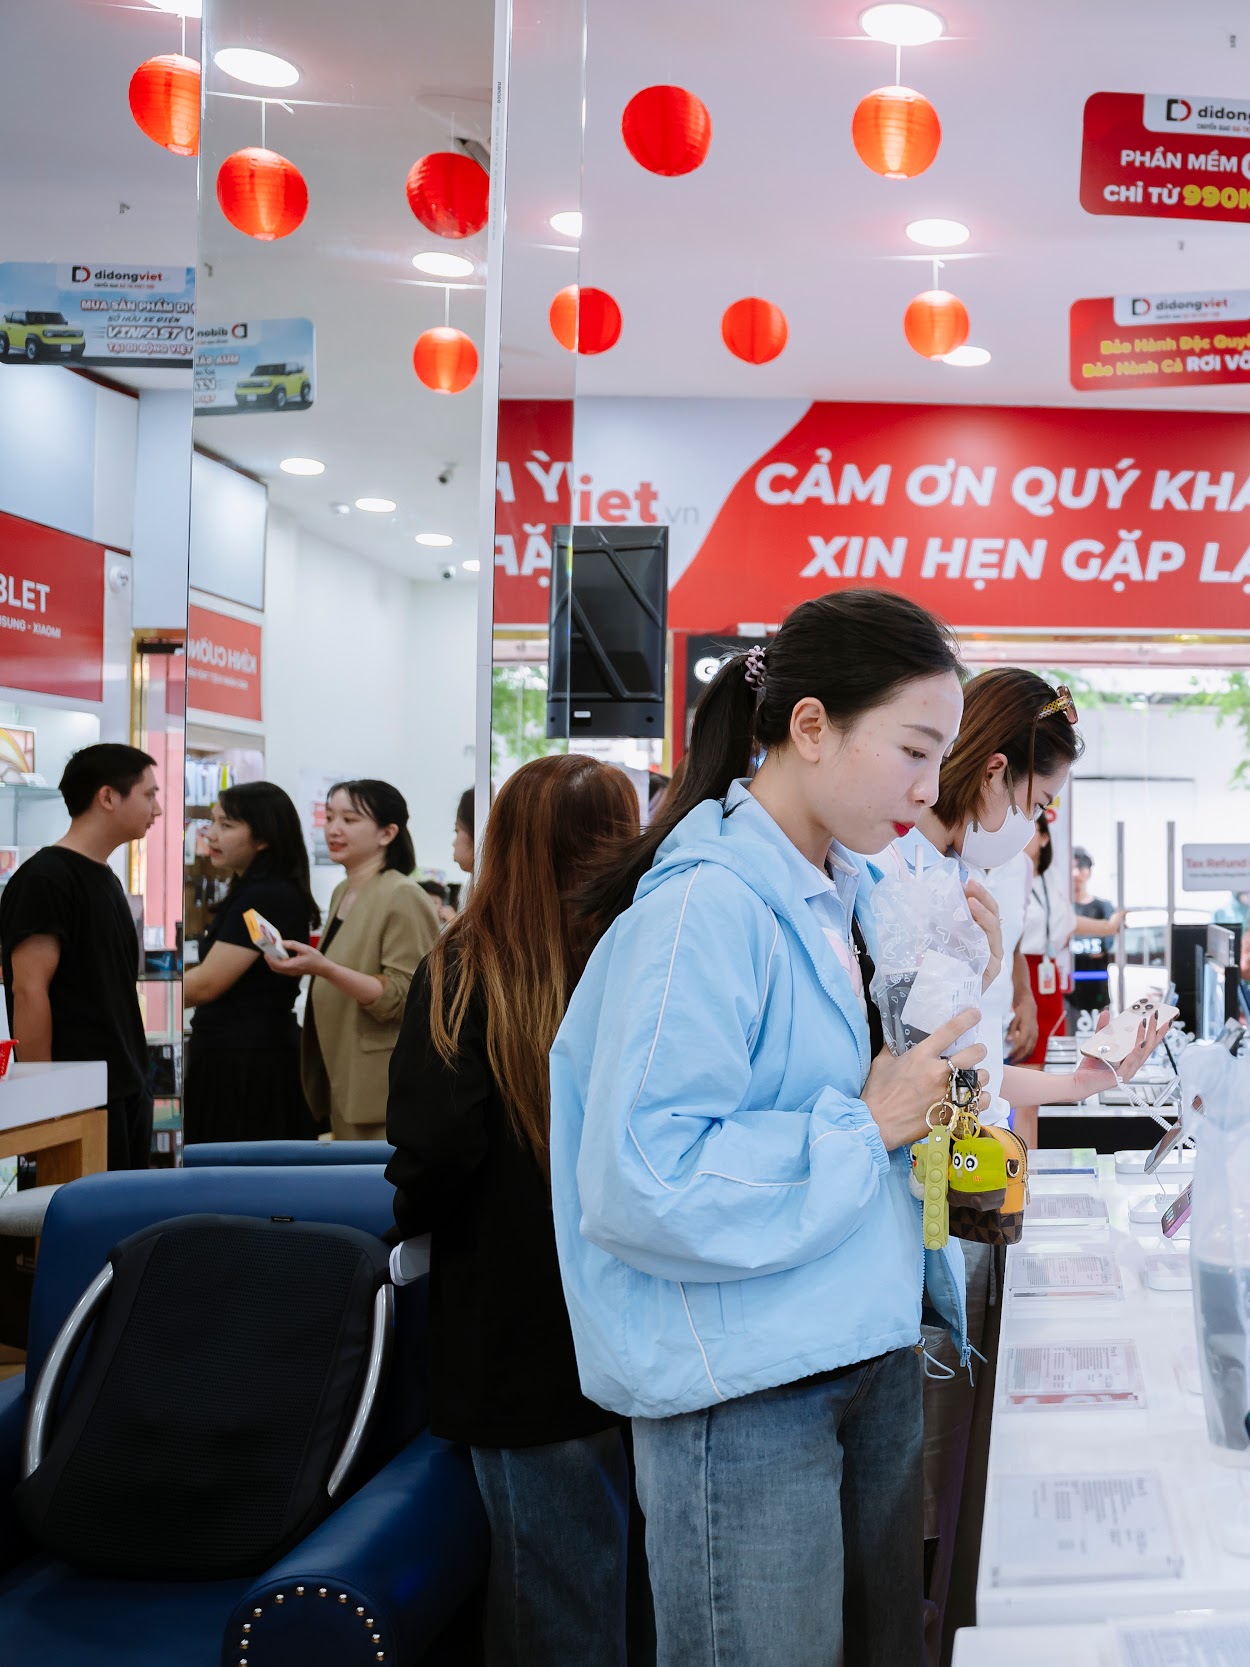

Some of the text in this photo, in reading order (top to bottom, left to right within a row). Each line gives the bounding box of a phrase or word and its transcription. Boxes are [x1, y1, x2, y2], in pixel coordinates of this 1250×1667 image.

[1187, 149, 1238, 173] MỀM
[1103, 181, 1143, 203] CHỈ
[1148, 183, 1181, 205] TỪ
[81, 299, 108, 312] MUA
[754, 447, 892, 506] CẢM
[905, 457, 997, 507] ƠN
[1011, 457, 1142, 517] QUÝ
[800, 535, 908, 578] XIN
[920, 537, 1047, 591] HẸN
[1061, 529, 1186, 593] GẶP
